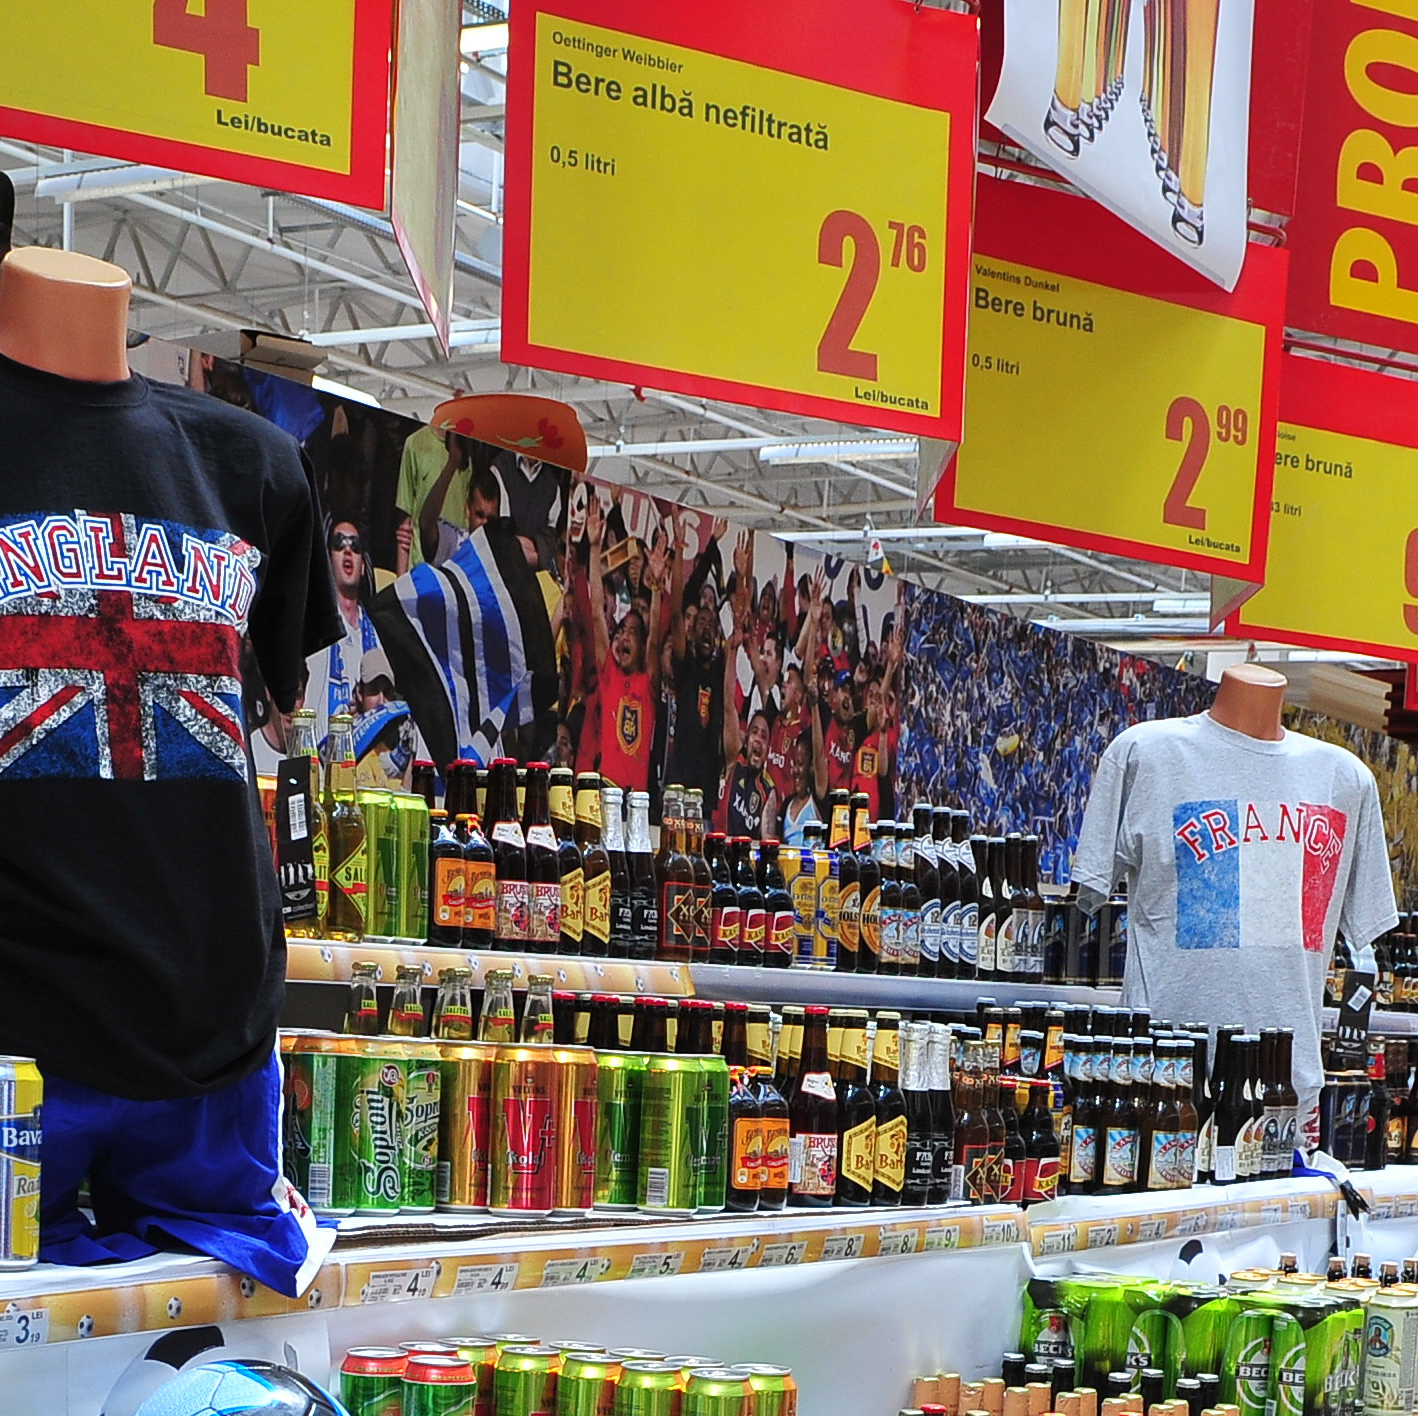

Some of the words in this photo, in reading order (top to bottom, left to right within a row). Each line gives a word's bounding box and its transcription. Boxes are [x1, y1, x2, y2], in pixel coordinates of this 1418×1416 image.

[551, 30, 618, 63] Oettinger
[622, 44, 684, 75] Weibbier
[551, 59, 622, 103] Bere
[631, 72, 695, 118] albă
[704, 97, 830, 152] nefiltrată
[215, 108, 332, 146] Lei/bucata
[549, 143, 579, 169] 0,5
[584, 150, 617, 177] litri
[816, 209, 881, 381] 2
[887, 219, 927, 273] 76
[975, 264, 1019, 285] Valentins
[1023, 273, 1060, 294] Dunkel
[973, 287, 1026, 321] Bere
[1031, 296, 1094, 333] brună
[971, 353, 992, 371] 0,5
[996, 357, 1020, 376] litri
[854, 385, 930, 411] Lei/bucata
[1162, 395, 1210, 531] 2
[1216, 404, 1248, 446] 99
[1306, 454, 1352, 478] brună
[1188, 533, 1241, 554] Lei/bucata
[1176, 802, 1343, 874] FRANCE
